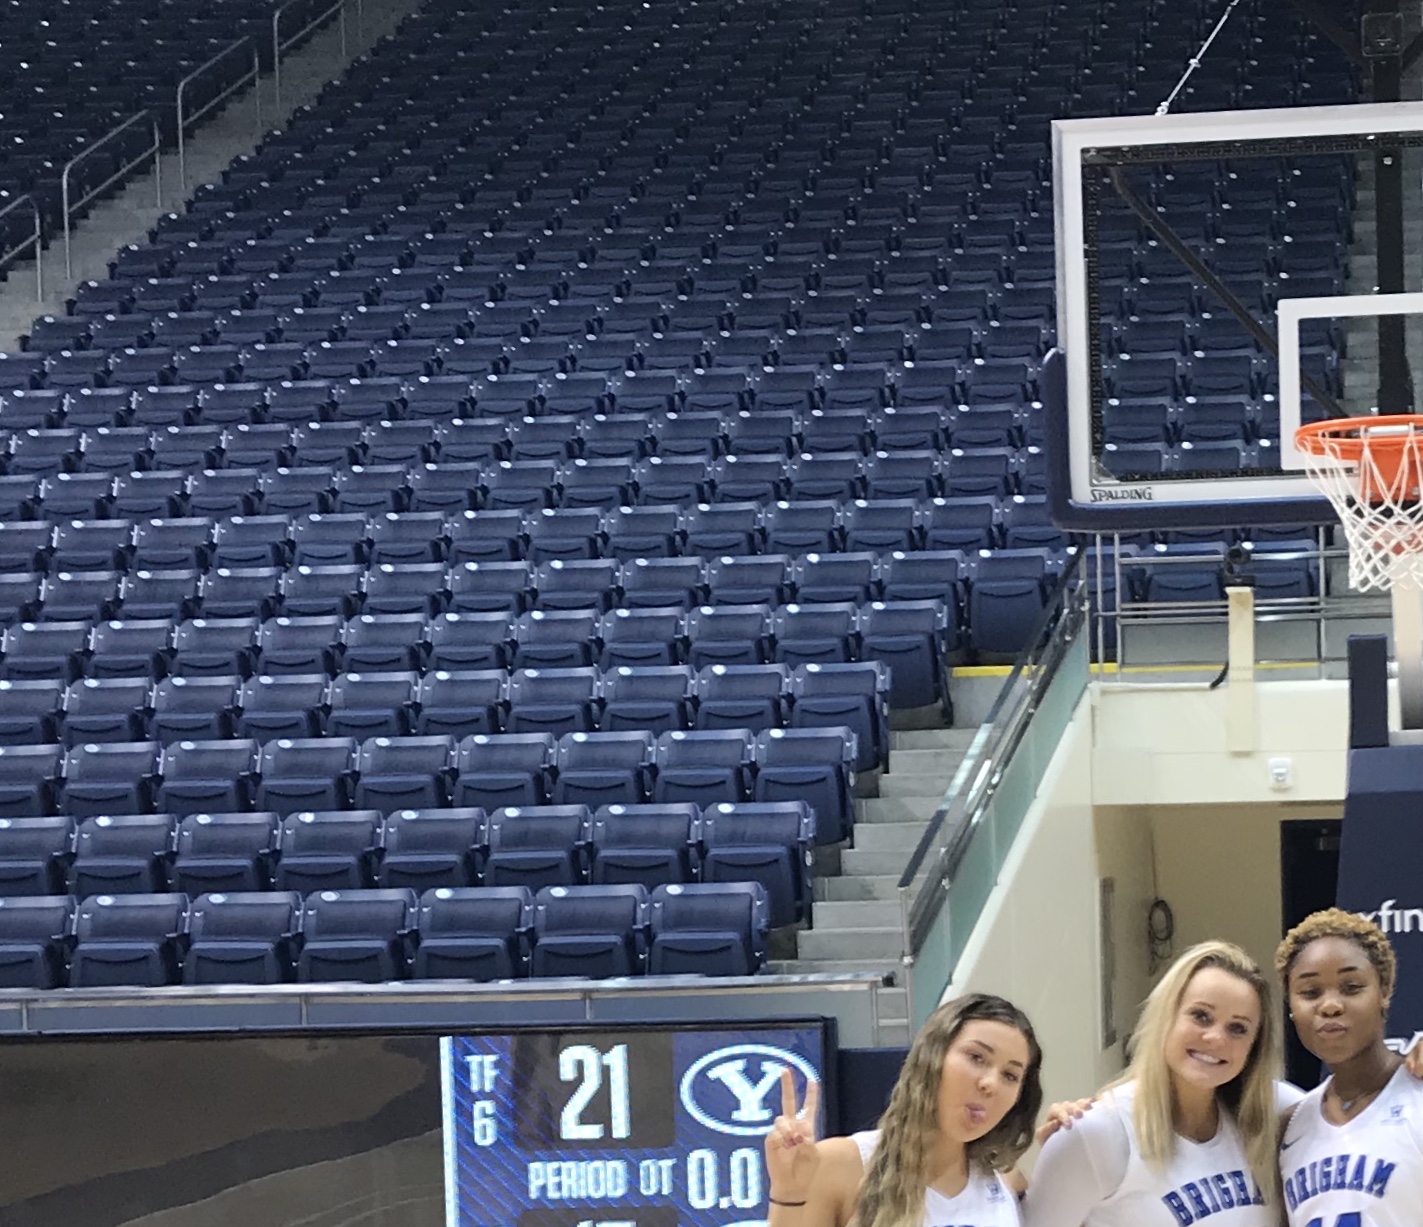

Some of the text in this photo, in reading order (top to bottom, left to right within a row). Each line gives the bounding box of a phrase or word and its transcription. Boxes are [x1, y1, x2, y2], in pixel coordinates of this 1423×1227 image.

[1090, 487, 1153, 502] SPALDING
[464, 1055, 500, 1093] TF
[559, 1044, 631, 1140] 21
[473, 1101, 498, 1146] 6
[528, 1158, 677, 1199] PERIOD OT
[686, 1148, 762, 1209] 0.0
